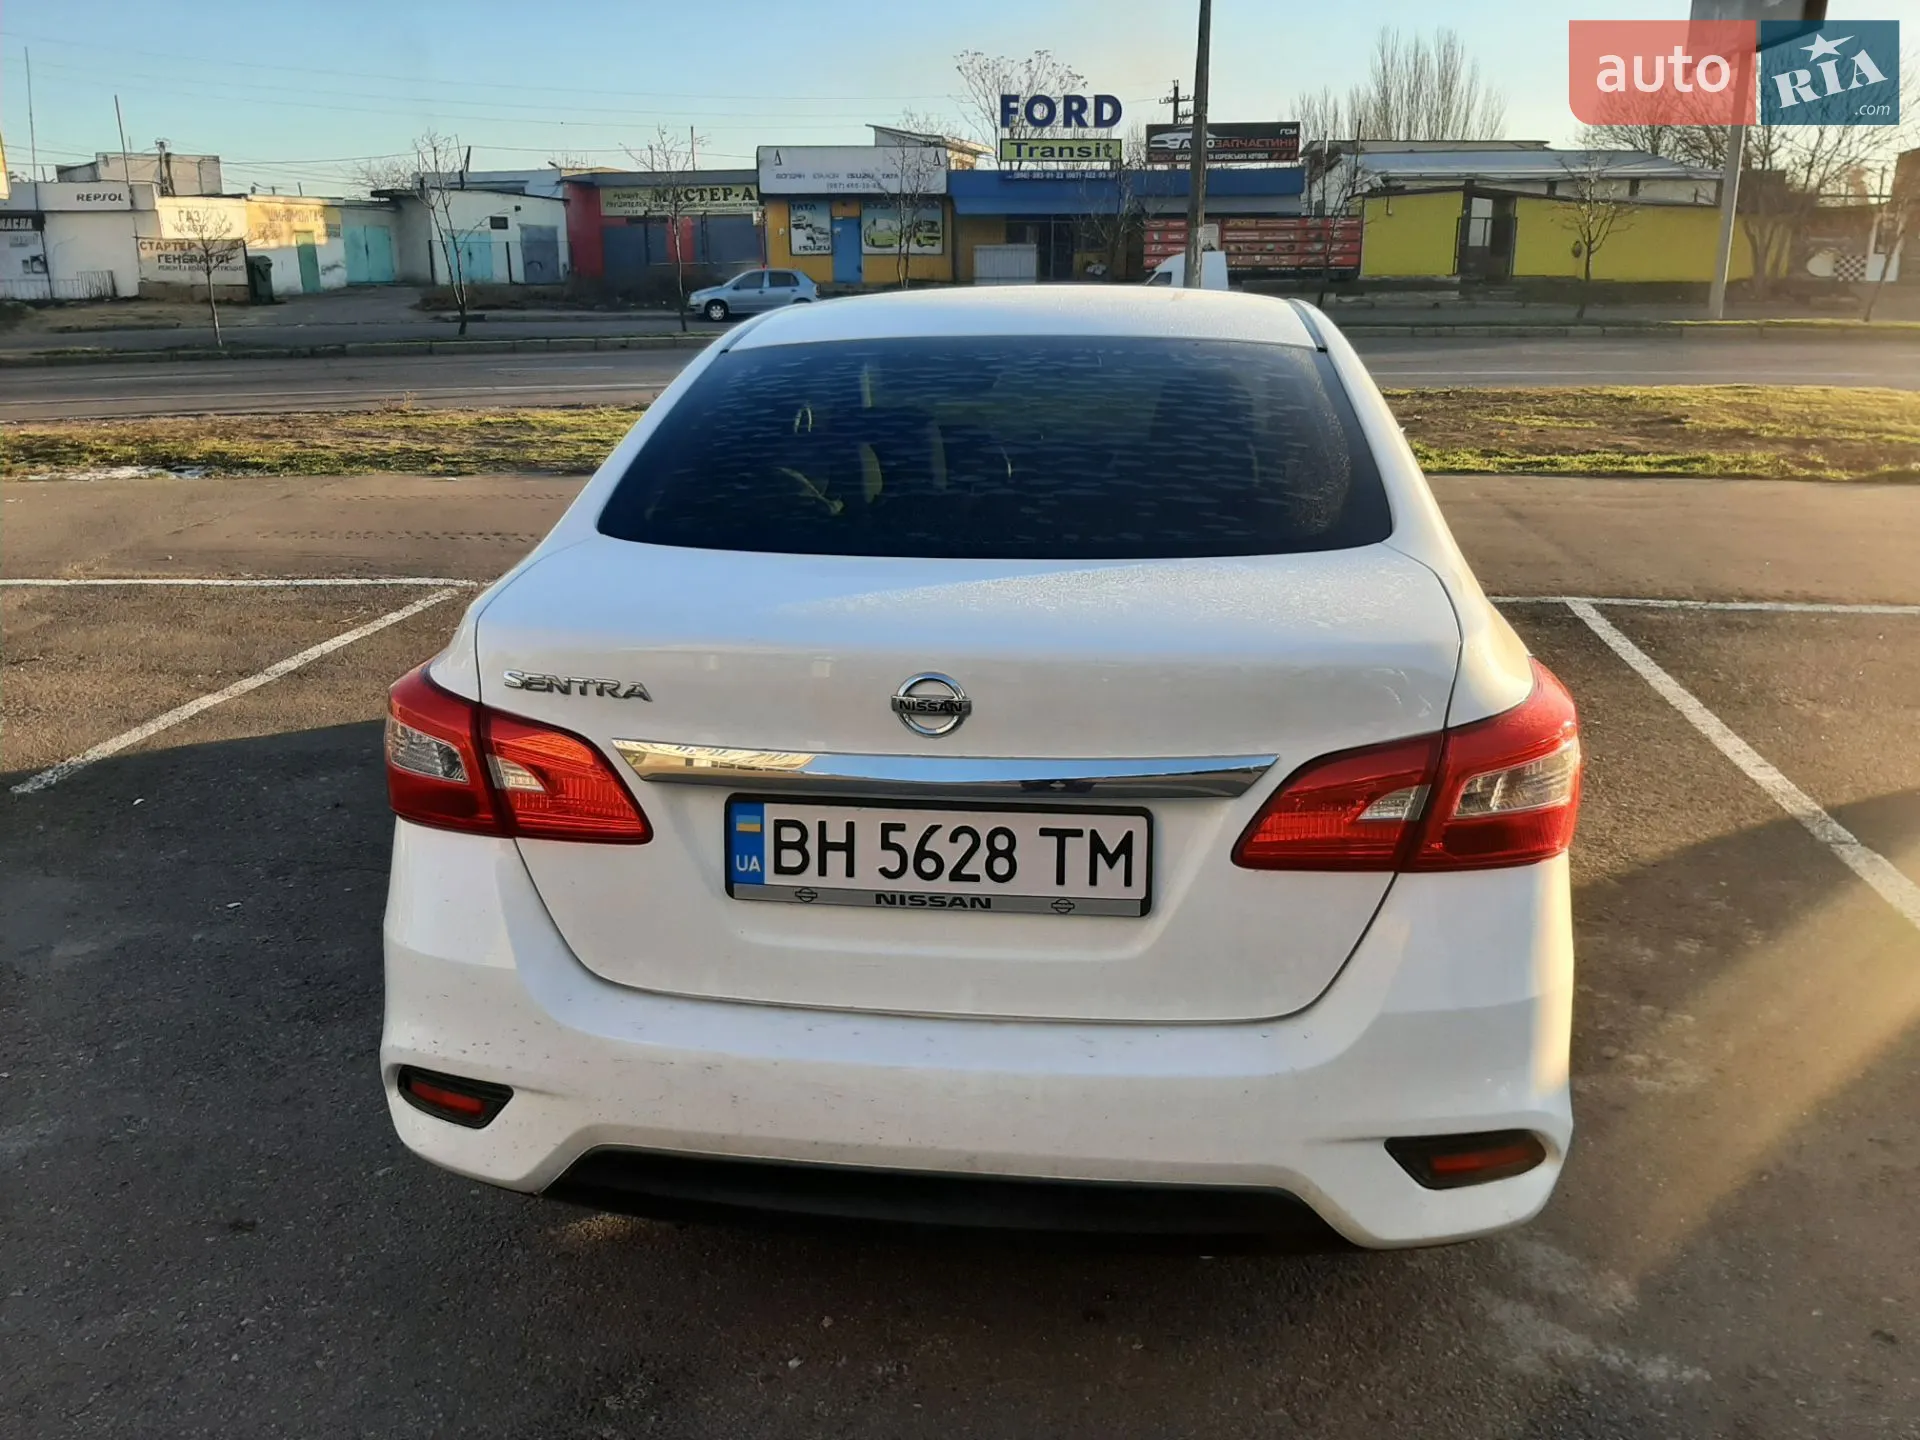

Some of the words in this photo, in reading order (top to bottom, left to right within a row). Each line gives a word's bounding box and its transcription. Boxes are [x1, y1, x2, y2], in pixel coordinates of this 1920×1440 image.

[1000, 94, 1122, 128] FORD
[1009, 142, 1112, 158] Transit
[1181, 138, 1298, 149] АОЗАПЧАСТИНИ
[76, 193, 125, 202] REPSOL
[791, 203, 817, 211] TATA
[178, 210, 201, 223] ГАЗ
[503, 669, 653, 702] SENTRA
[898, 698, 963, 712] NISSAN
[773, 818, 855, 878] BH
[878, 822, 1018, 883] 5628
[1038, 827, 1133, 887] TM
[736, 854, 761, 872] UA
[875, 892, 992, 909] NISSAN
